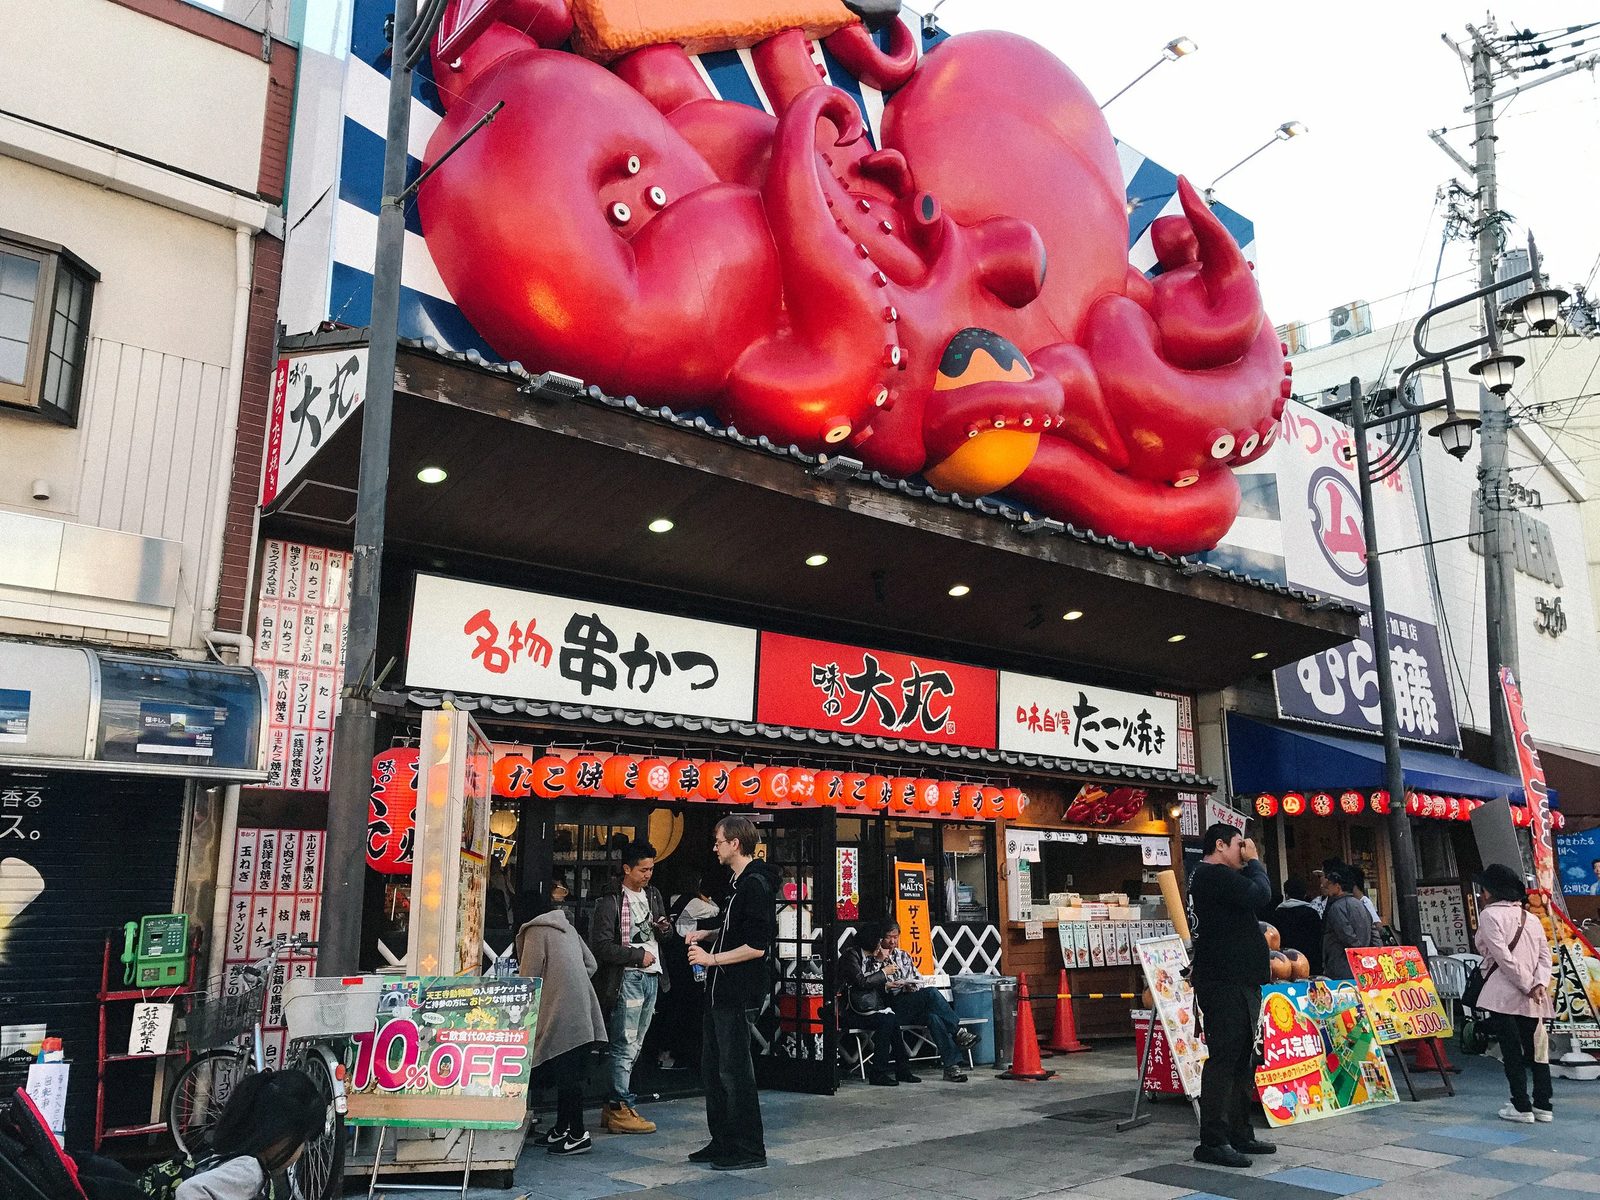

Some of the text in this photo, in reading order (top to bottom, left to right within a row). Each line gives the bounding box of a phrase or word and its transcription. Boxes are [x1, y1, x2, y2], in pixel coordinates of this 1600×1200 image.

[307, 561, 320, 599] いちご
[260, 616, 273, 651] 白ねぎ
[281, 619, 293, 653] いちご
[300, 616, 315, 662] 紅しょうが
[297, 683, 309, 724] マンゴー
[317, 686, 329, 720] たこ
[841, 652, 955, 734] 大丸
[312, 736, 325, 784] チャンジャ
[509, 762, 638, 791] たこ焼き
[1, 790, 42, 807] 香る
[259, 833, 275, 890] 一銭洋食焼き
[280, 832, 296, 890] すじ肉どて焼き
[302, 833, 317, 890] ホルモン煮込み
[1557, 837, 1595, 846] ゆきわたる
[238, 845, 252, 883] 玉ねぎ
[841, 849, 853, 897] 大募集
[900, 882, 924, 892] MALT'S
[1563, 884, 1591, 893] 公明党
[232, 901, 247, 954] チャンジャ
[254, 906, 268, 948] キムチ
[137, 1006, 160, 1054] 駐輪禁止
[439, 1031, 525, 1043] ご飲食代のお会計が
[428, 1042, 528, 1090] OFF
